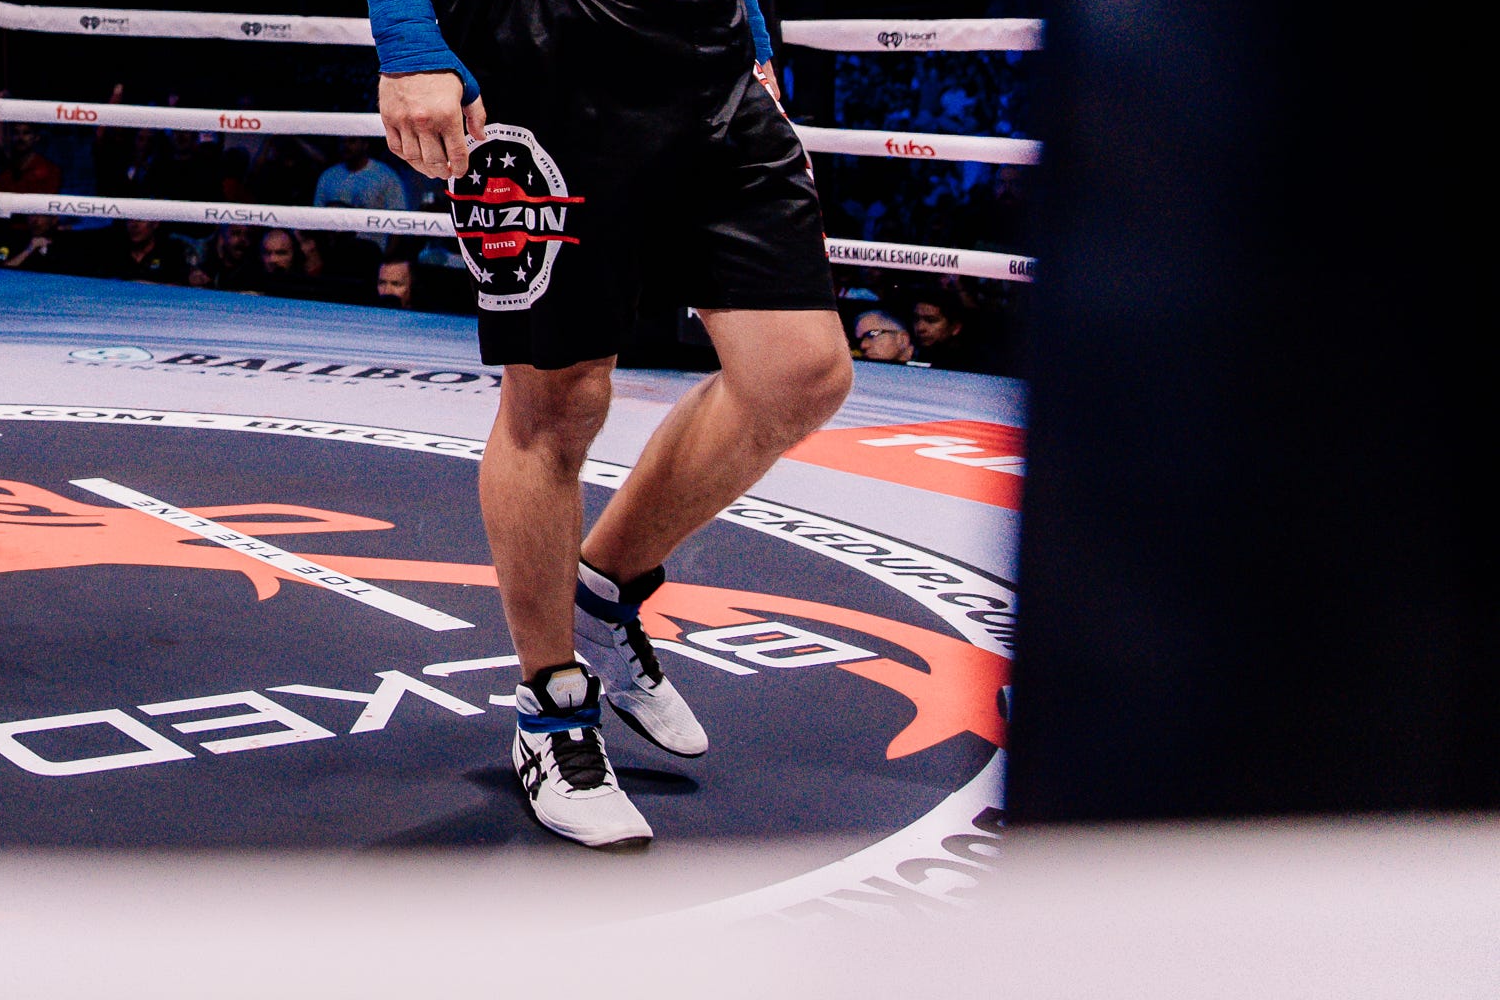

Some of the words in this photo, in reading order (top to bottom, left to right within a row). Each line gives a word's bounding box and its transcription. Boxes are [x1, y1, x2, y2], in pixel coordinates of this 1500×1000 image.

[56, 105, 98, 122] fubo
[219, 114, 261, 130] fubo
[540, 156, 560, 189] FITNESS
[47, 201, 121, 215] RASHA
[204, 208, 279, 223] RASHA
[451, 201, 567, 232] LAUZON
[366, 216, 443, 231] RASHA
[484, 240, 517, 250] mma
[829, 245, 960, 269] REKNUCKLESHOP.COM
[244, 421, 485, 455] BKFC.C
[857, 433, 1027, 477] fu
[132, 499, 209, 529] LINE
[216, 533, 284, 559] THE
[294, 566, 374, 597] TOE
[729, 503, 1019, 651] CKEDUP.CO
